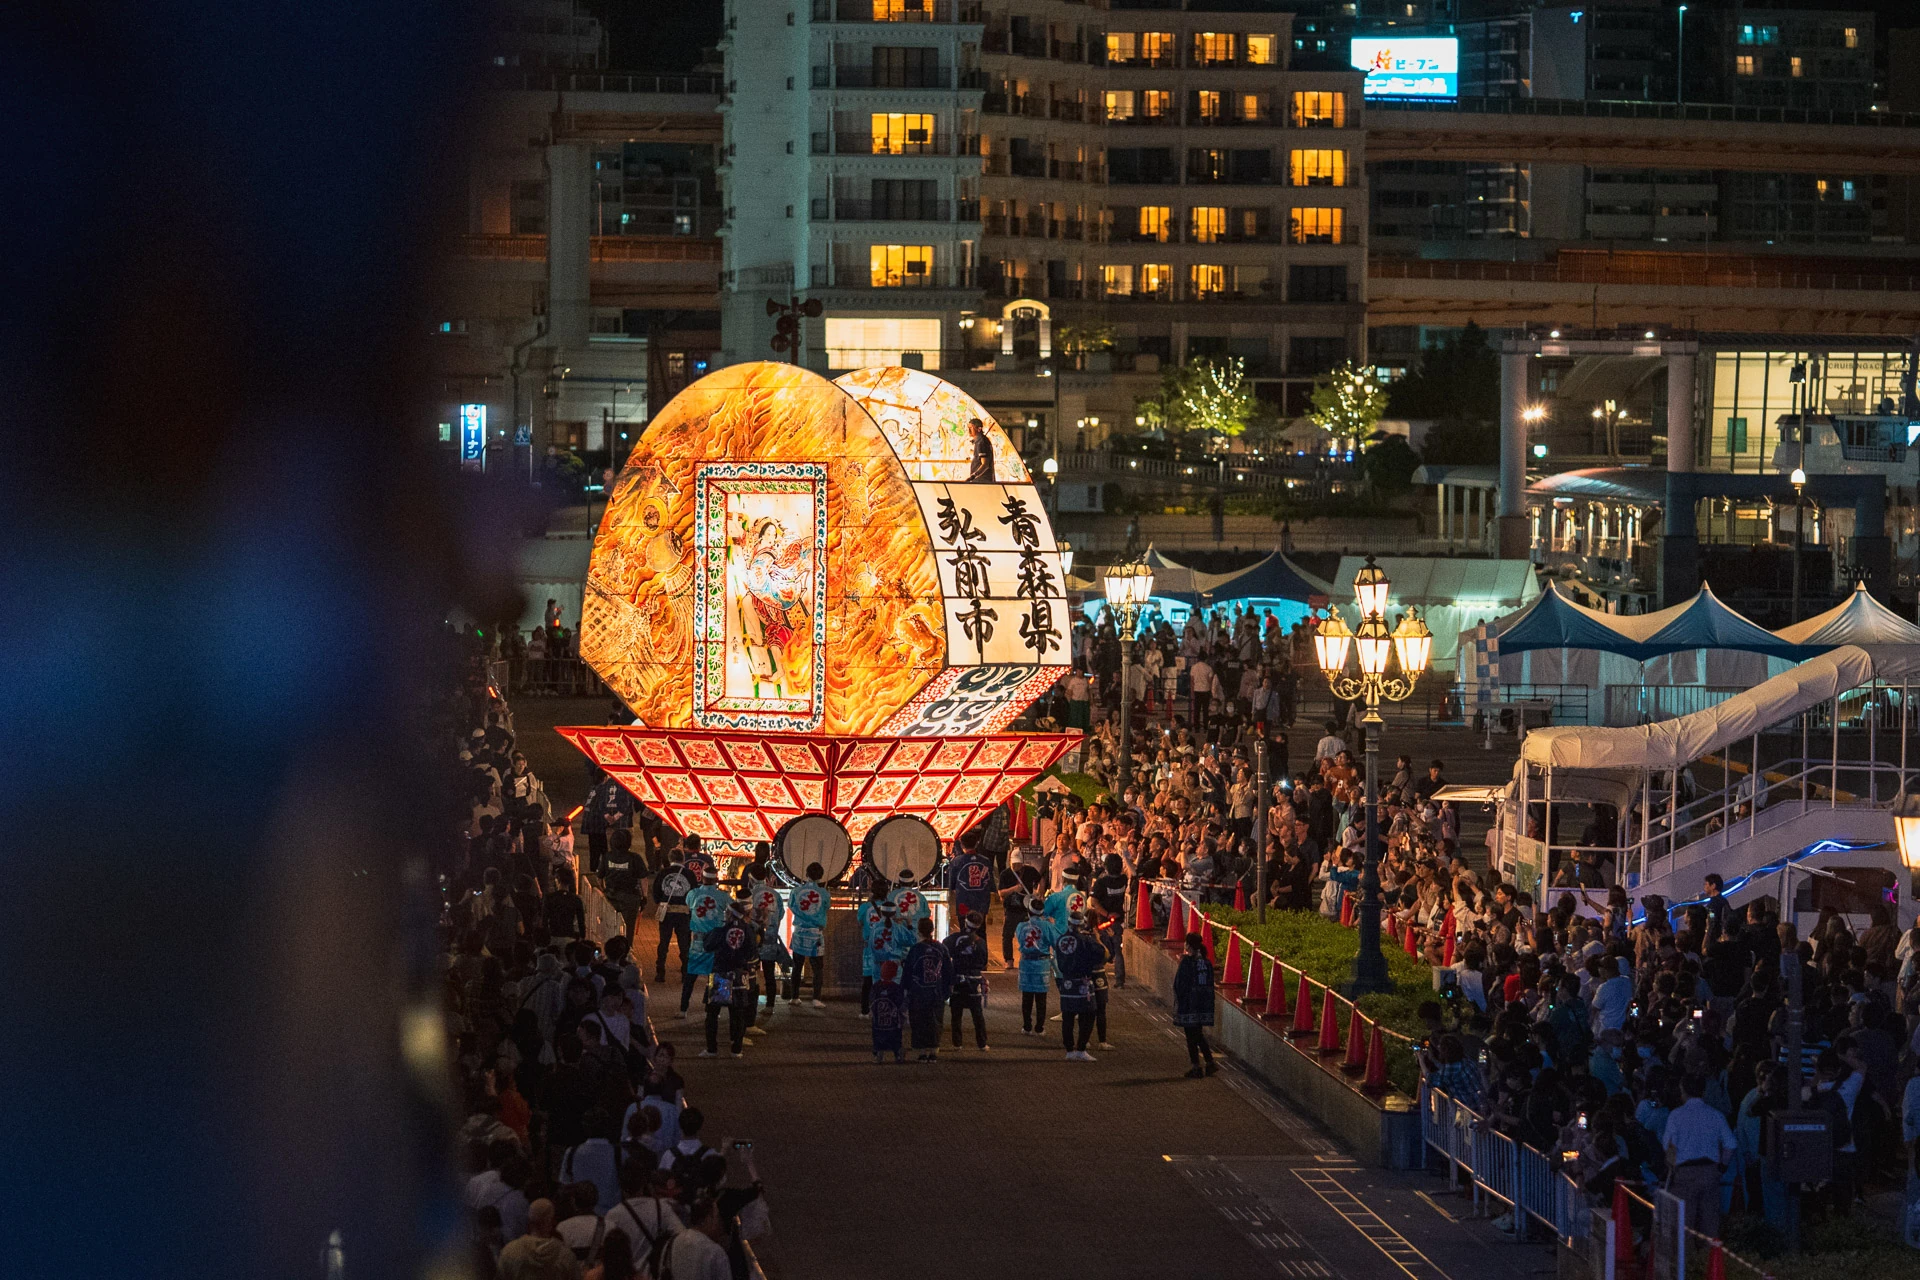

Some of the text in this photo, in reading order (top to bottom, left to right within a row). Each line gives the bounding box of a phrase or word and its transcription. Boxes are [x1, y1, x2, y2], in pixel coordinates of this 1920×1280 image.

[467, 419, 479, 459] コーナン
[936, 497, 999, 654] 弘前市
[997, 495, 1063, 655] 青森県
